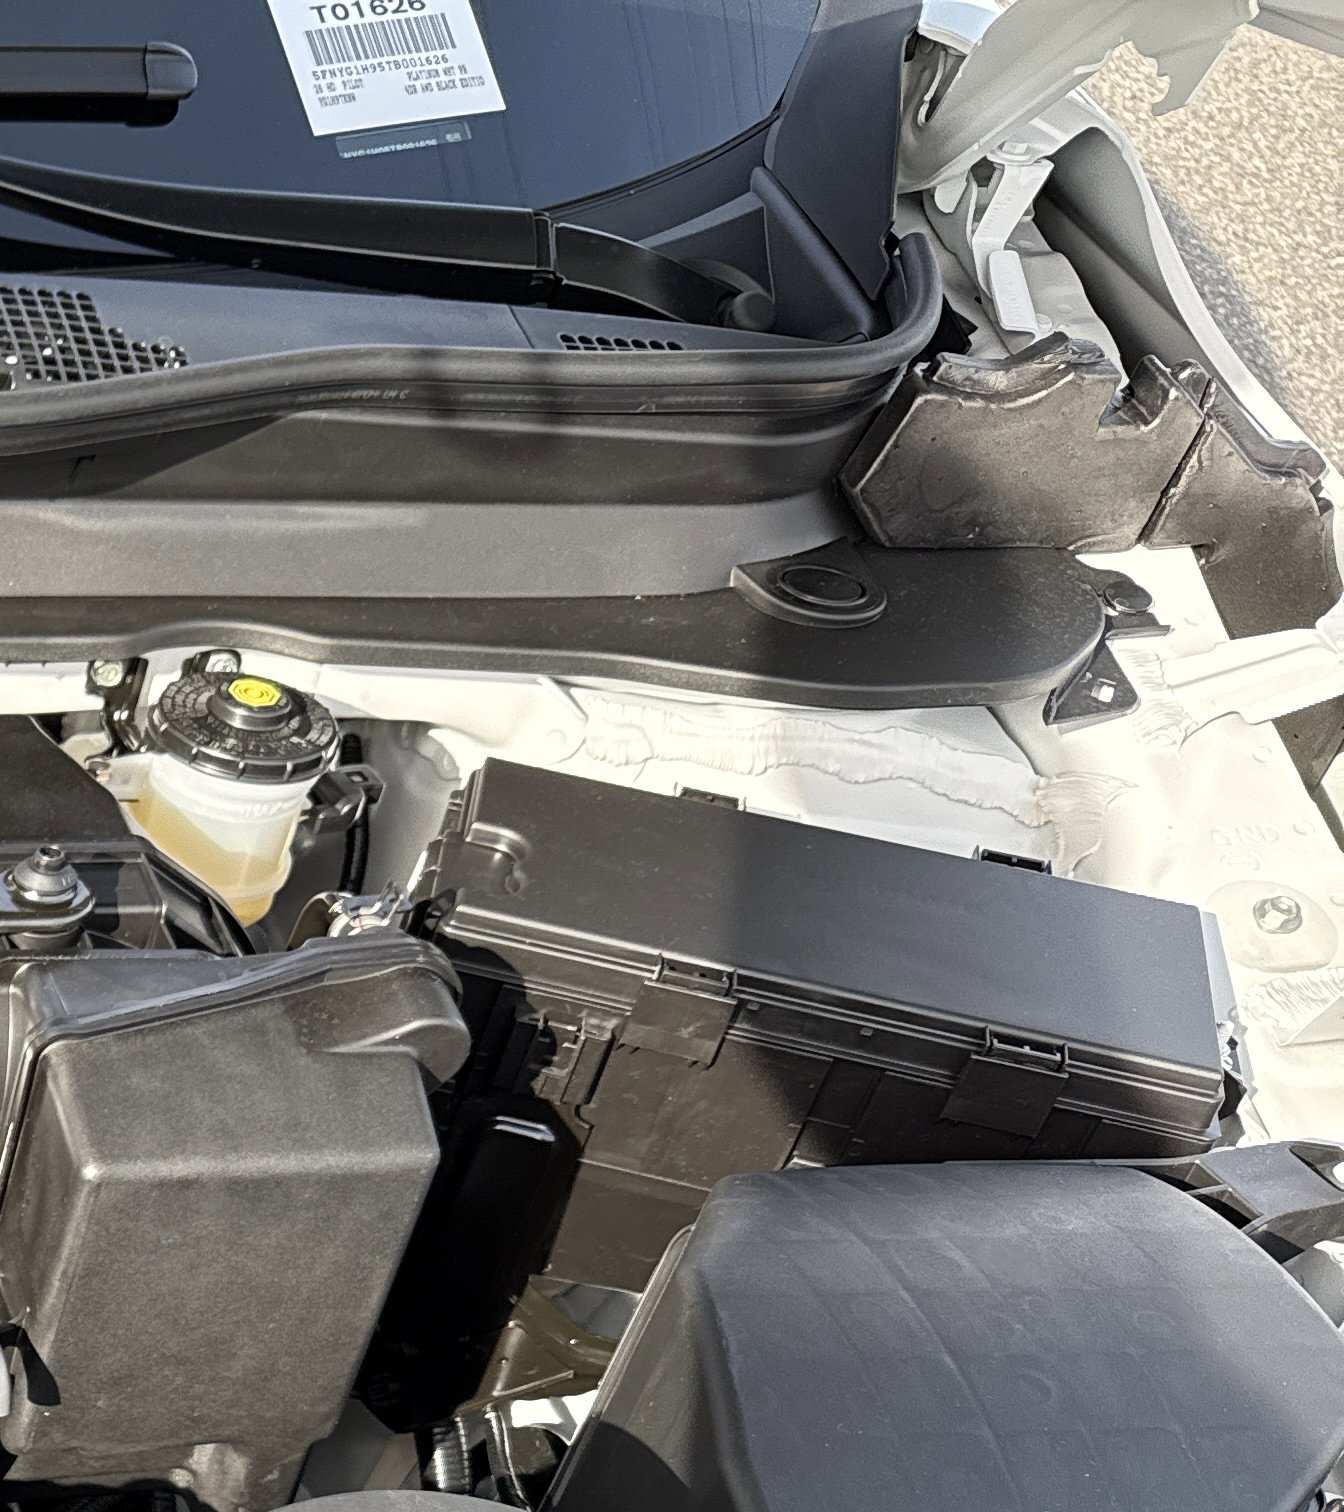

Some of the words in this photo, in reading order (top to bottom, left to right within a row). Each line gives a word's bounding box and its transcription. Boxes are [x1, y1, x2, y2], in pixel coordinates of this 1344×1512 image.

[312, 53, 449, 81] 5FNYG1H95TB001626
[436, 79, 458, 91] BLACK
[459, 75, 485, 89] EDITIO
[1210, 823, 1280, 846] GND
